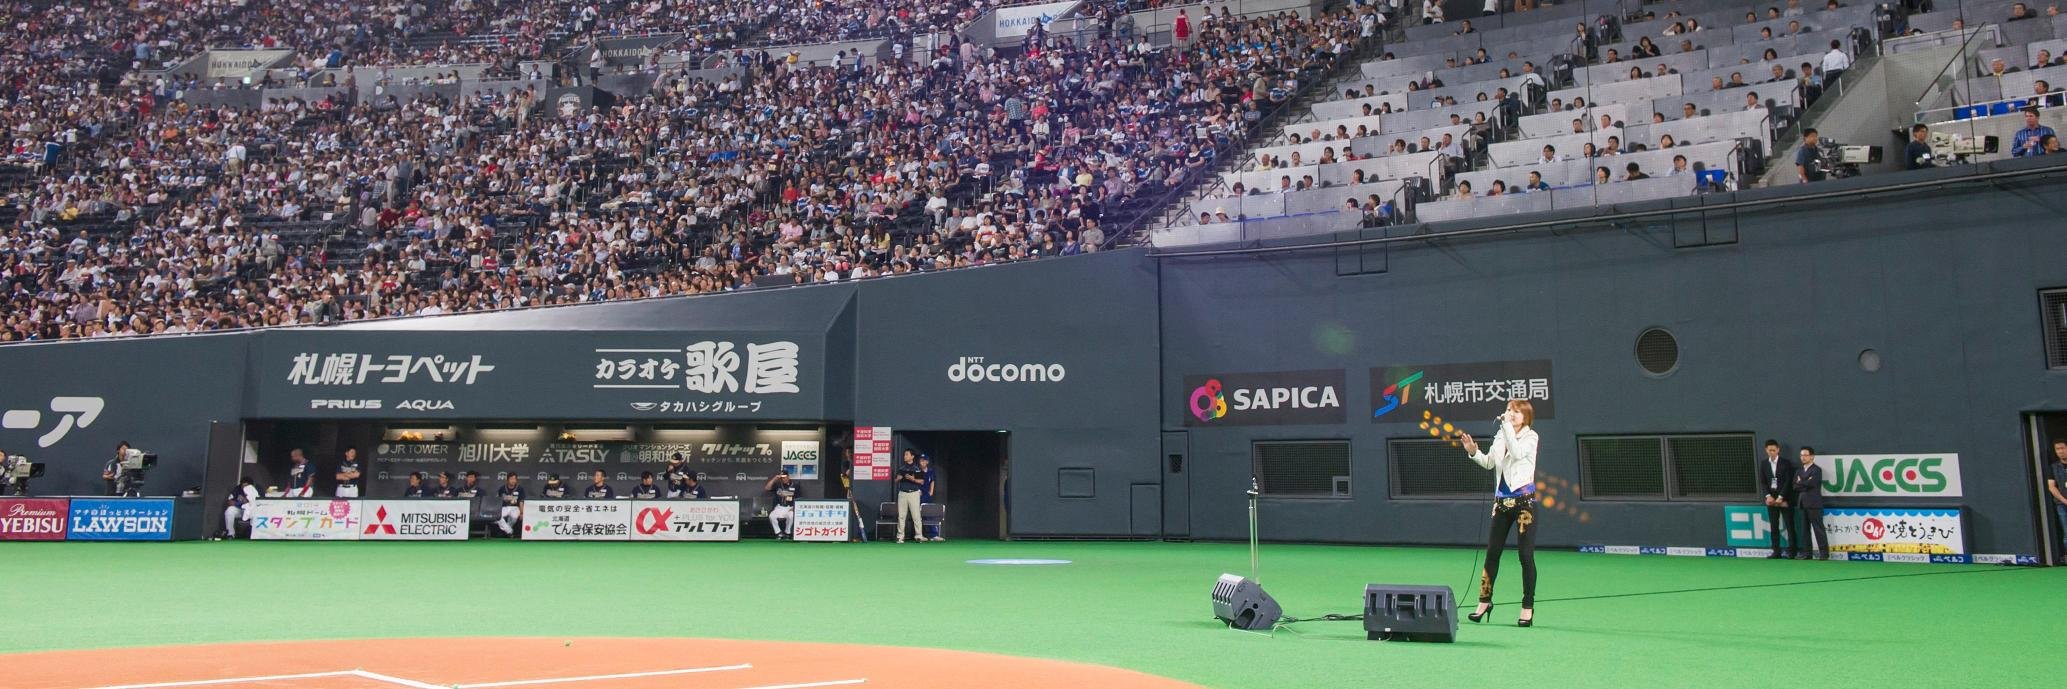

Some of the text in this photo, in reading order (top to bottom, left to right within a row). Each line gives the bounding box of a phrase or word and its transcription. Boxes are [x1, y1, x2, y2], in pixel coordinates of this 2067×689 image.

[1000, 16, 1041, 28] HOKKAID
[287, 352, 495, 385] 札幌トヨペット
[595, 358, 680, 380] カラオケ
[685, 340, 800, 394] 歌屋
[947, 357, 1065, 382] docomo
[1424, 378, 1549, 405] 札幌市交通局
[1233, 386, 1339, 411] SAPICA
[311, 400, 455, 411] PRIUS AQUA
[660, 401, 762, 413] タカハシグループ
[390, 444, 448, 455] JR TOWER
[458, 443, 530, 463] 旭川大学
[555, 449, 610, 463] TASLY
[701, 443, 772, 456] クリナップ
[783, 450, 817, 460] JACCS
[1822, 458, 1947, 493] JACCS
[8, 503, 56, 517] Premium
[539, 505, 617, 513] 電気の安全・省エネは
[72, 516, 167, 533] LAWSON
[401, 513, 466, 523] MITSUBISHI
[0, 517, 63, 533] YEBISU
[400, 525, 457, 535] ELECTRIC
[552, 523, 627, 535] でんき保安協会
[673, 522, 734, 532] アルファ
[796, 527, 846, 536] シゴトガイド
